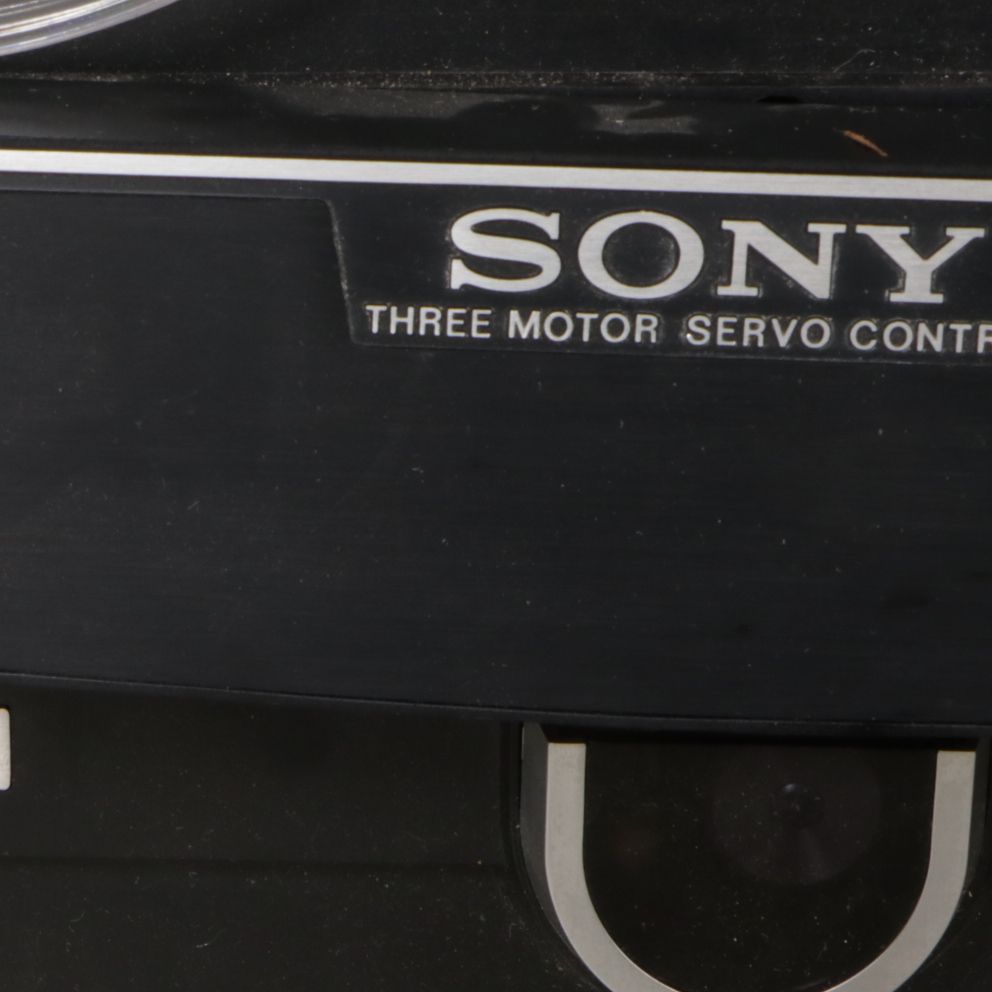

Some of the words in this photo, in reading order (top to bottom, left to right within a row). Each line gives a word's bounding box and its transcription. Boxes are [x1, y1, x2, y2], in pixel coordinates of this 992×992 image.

[446, 208, 985, 303] SONY
[366, 305, 491, 338] THREE
[509, 310, 657, 343] MOTOR
[685, 314, 831, 348] SERVO
